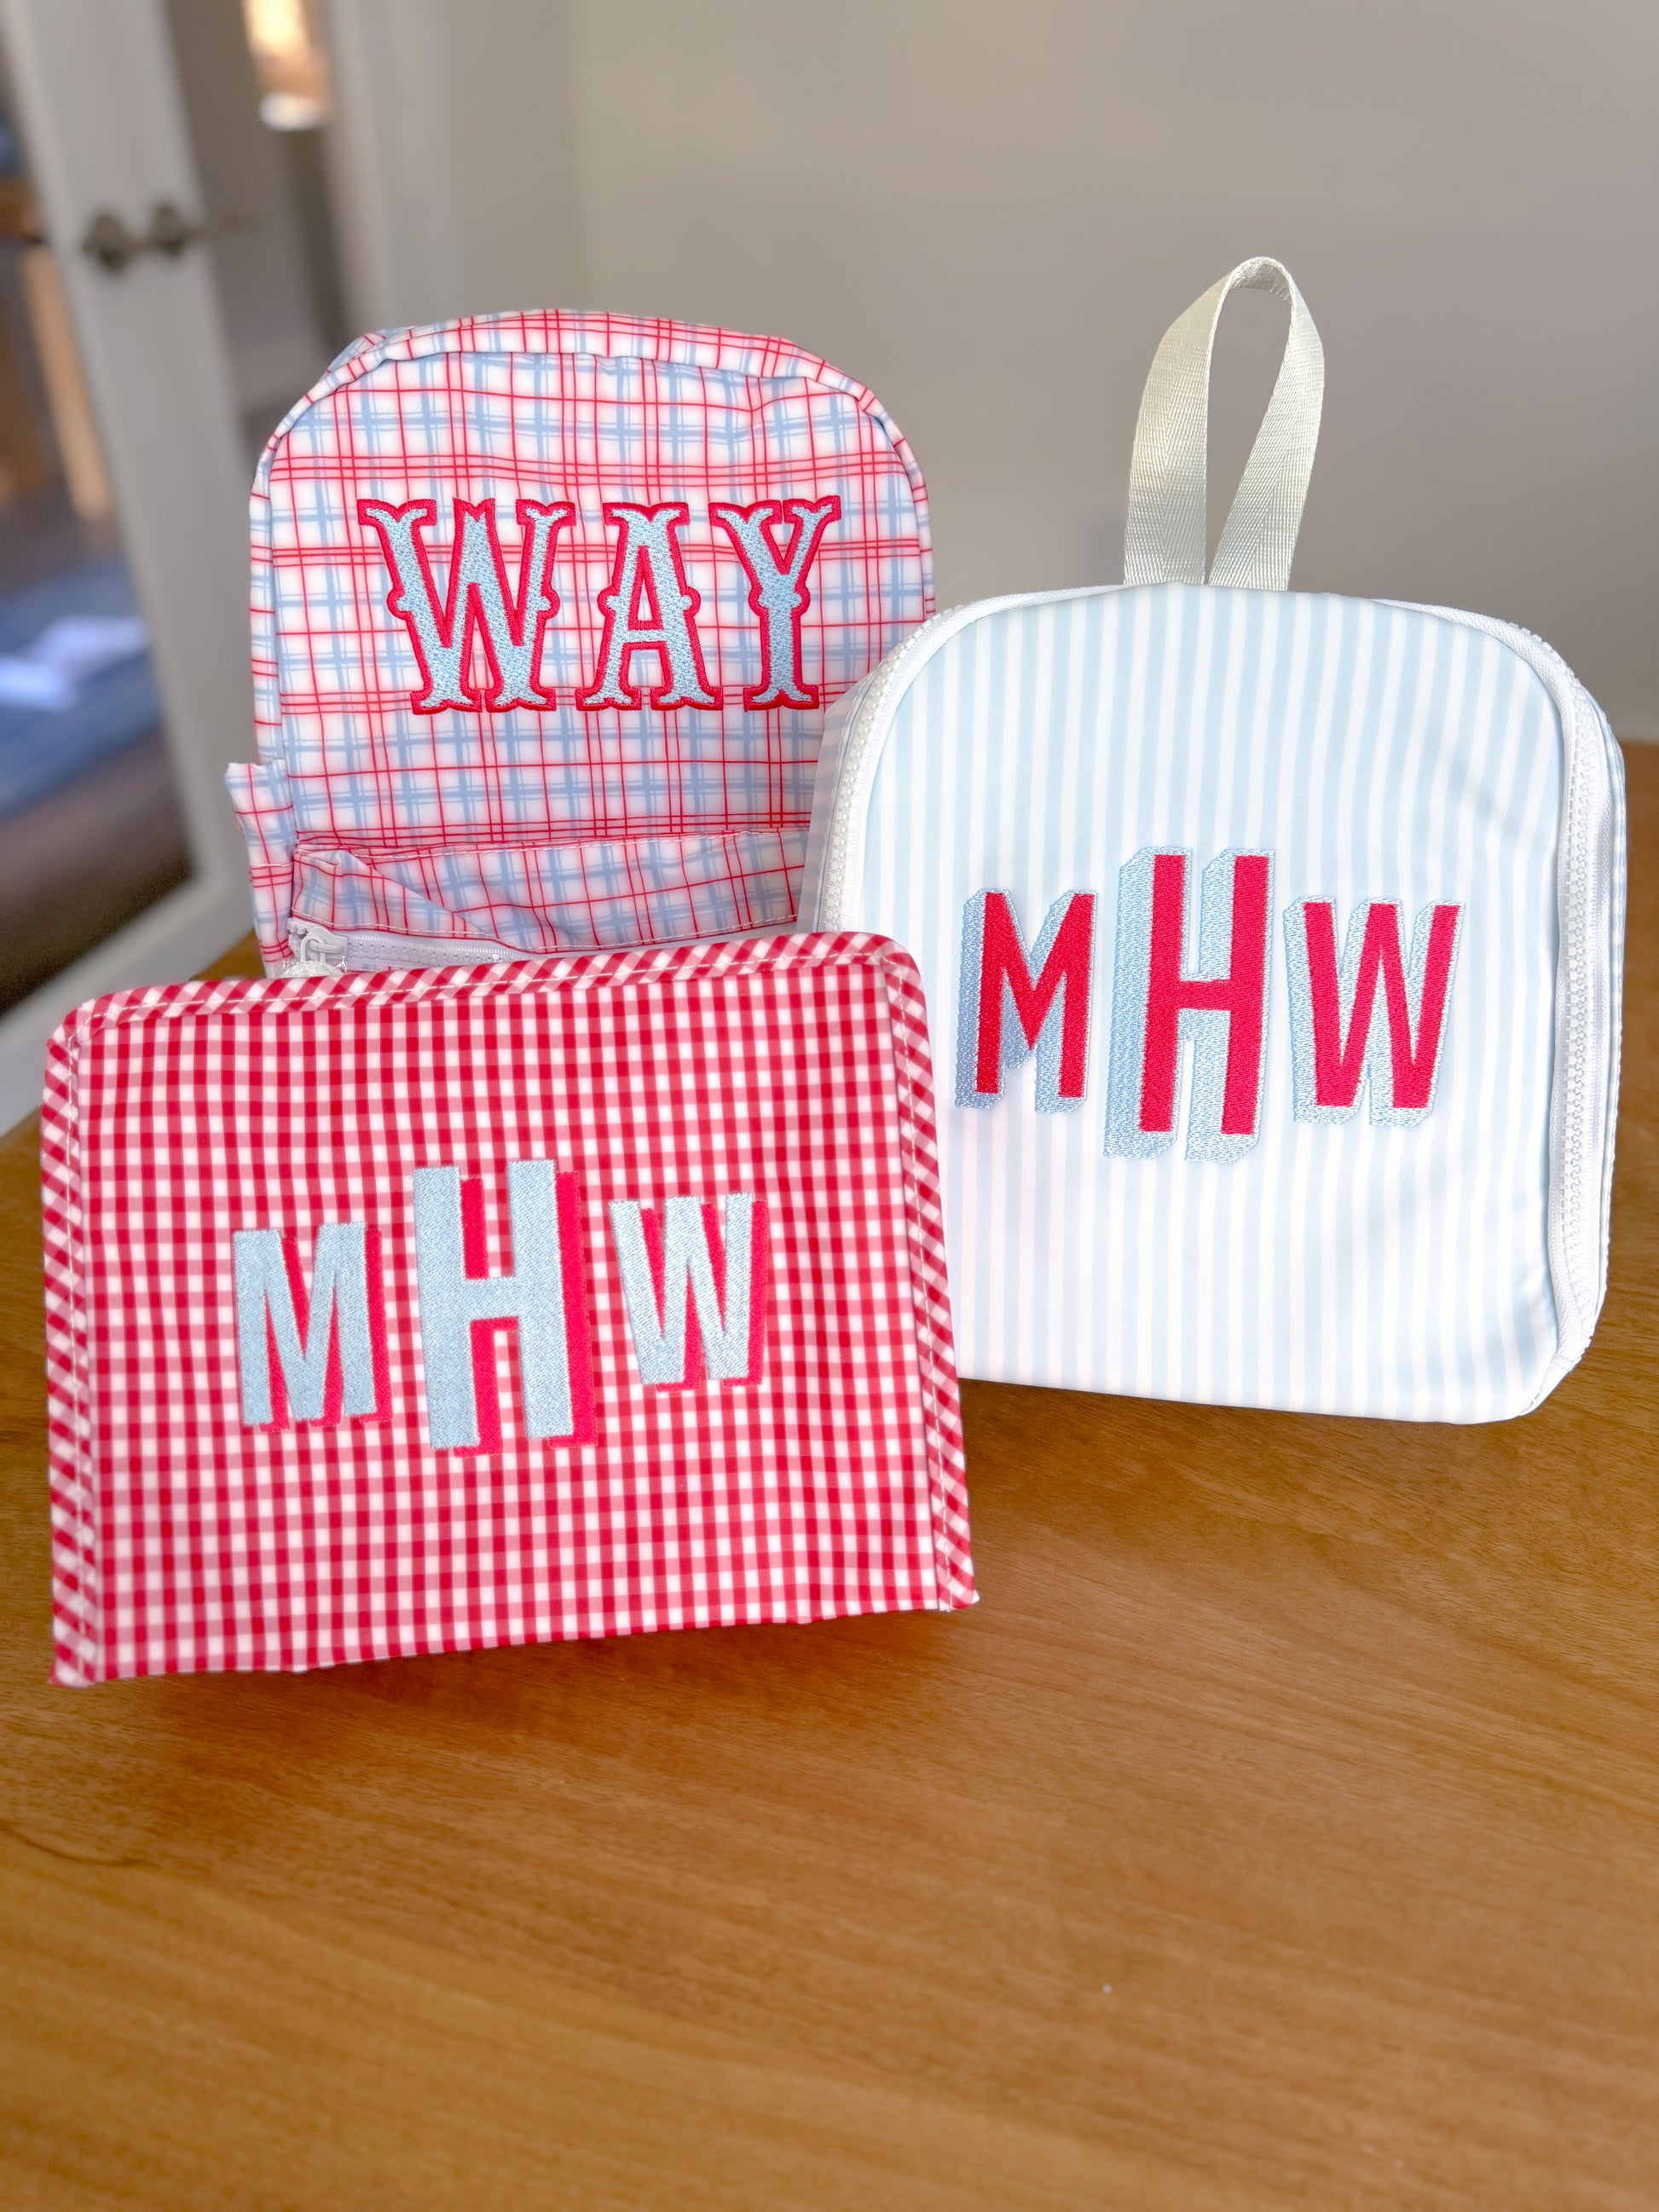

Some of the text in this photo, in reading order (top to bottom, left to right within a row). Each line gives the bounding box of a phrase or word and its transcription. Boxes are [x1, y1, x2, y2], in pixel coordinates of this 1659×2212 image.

[356, 495, 842, 713] WAY
[955, 847, 1465, 1161] MHW
[233, 1158, 768, 1457] MHW
